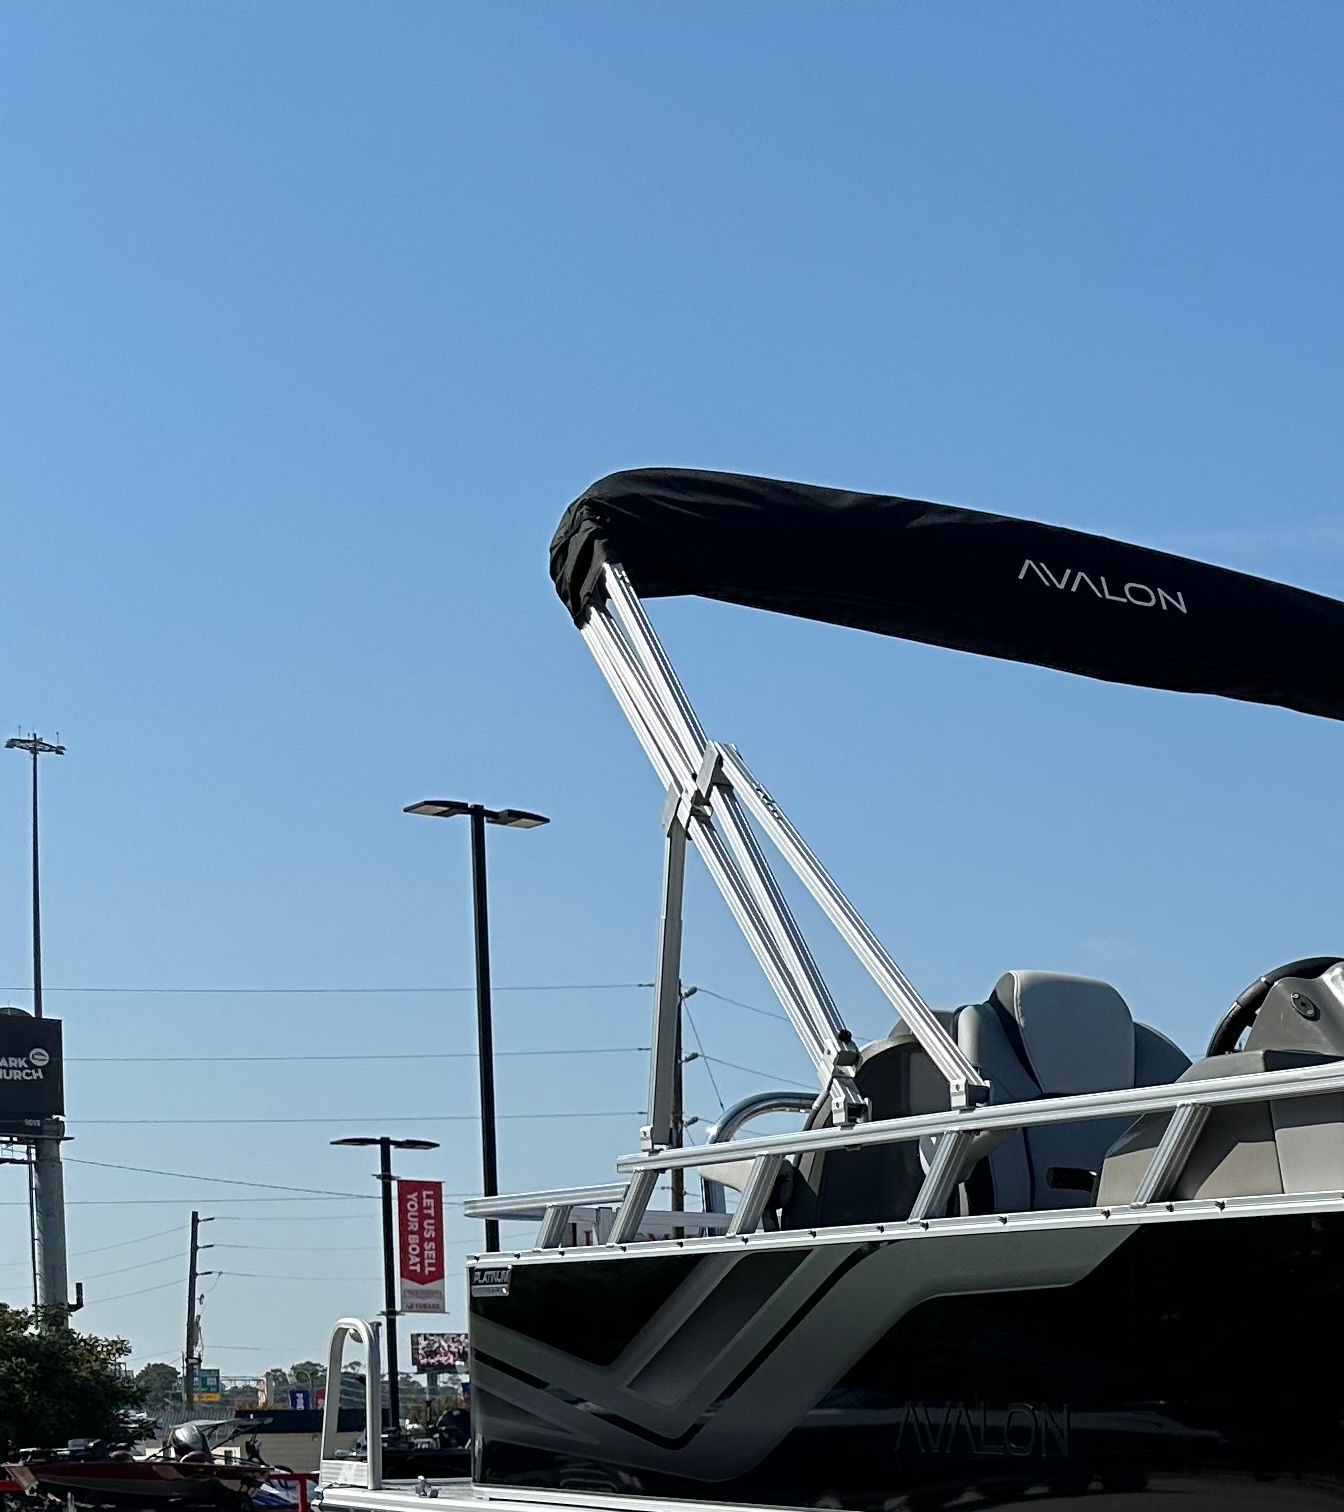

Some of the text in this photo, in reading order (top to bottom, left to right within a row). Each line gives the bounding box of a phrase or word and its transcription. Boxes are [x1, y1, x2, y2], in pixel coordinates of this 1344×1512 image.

[1017, 558, 1188, 614] AVALON
[406, 1192, 420, 1273] YOUR BOAT
[422, 1190, 436, 1275] LET US SELL
[895, 1400, 1070, 1458] AVALON
